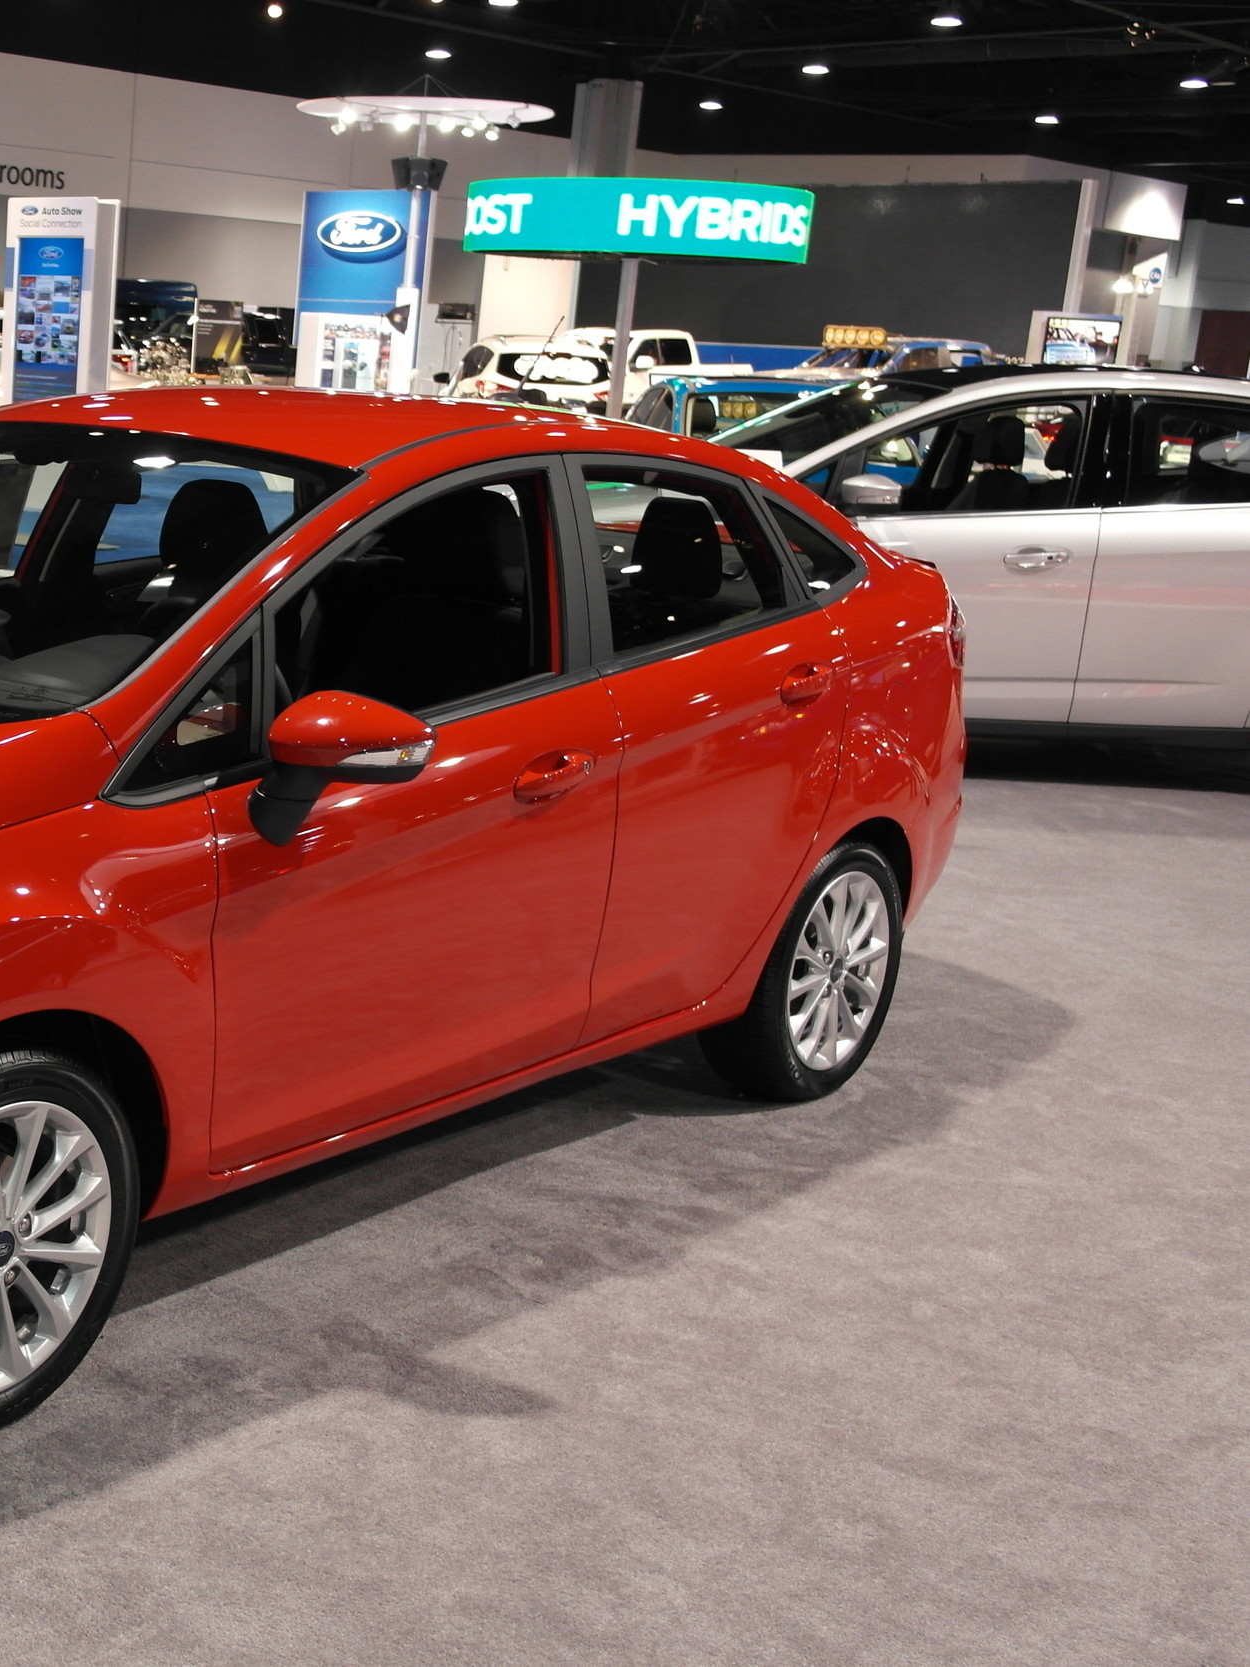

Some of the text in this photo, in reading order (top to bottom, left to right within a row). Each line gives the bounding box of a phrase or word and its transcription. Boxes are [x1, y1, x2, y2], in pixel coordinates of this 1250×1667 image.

[42, 207, 60, 215] Auto
[61, 207, 83, 215] Show
[464, 193, 809, 247] OST HYBRIDS
[20, 219, 82, 228] Social Connection
[330, 216, 384, 246] Ford
